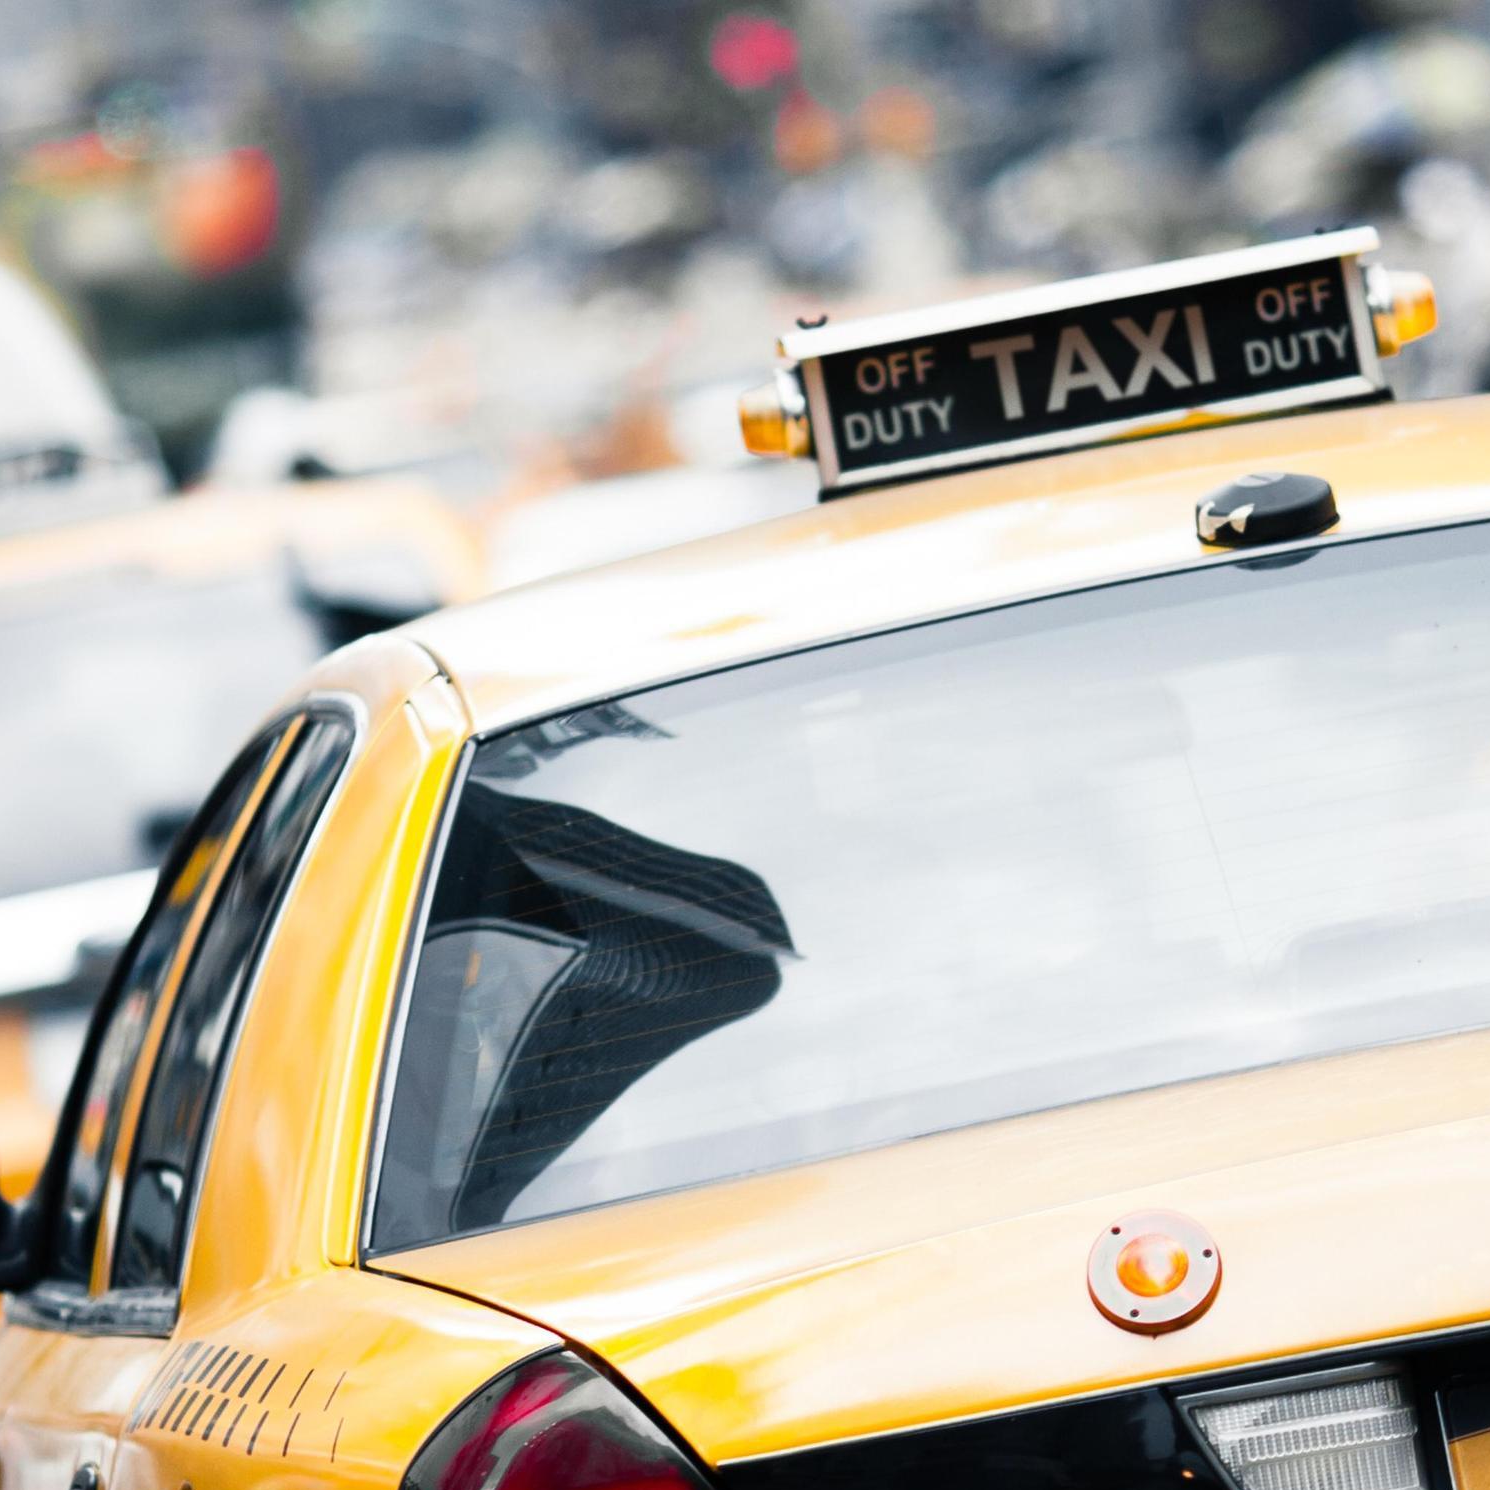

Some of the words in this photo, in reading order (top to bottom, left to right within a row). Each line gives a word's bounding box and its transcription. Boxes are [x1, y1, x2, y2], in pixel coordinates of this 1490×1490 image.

[1255, 277, 1332, 322] OFF
[856, 345, 935, 395] OFF
[969, 303, 1217, 421] TAXI
[1244, 324, 1349, 376] DUTY
[843, 395, 954, 451] DUTY
